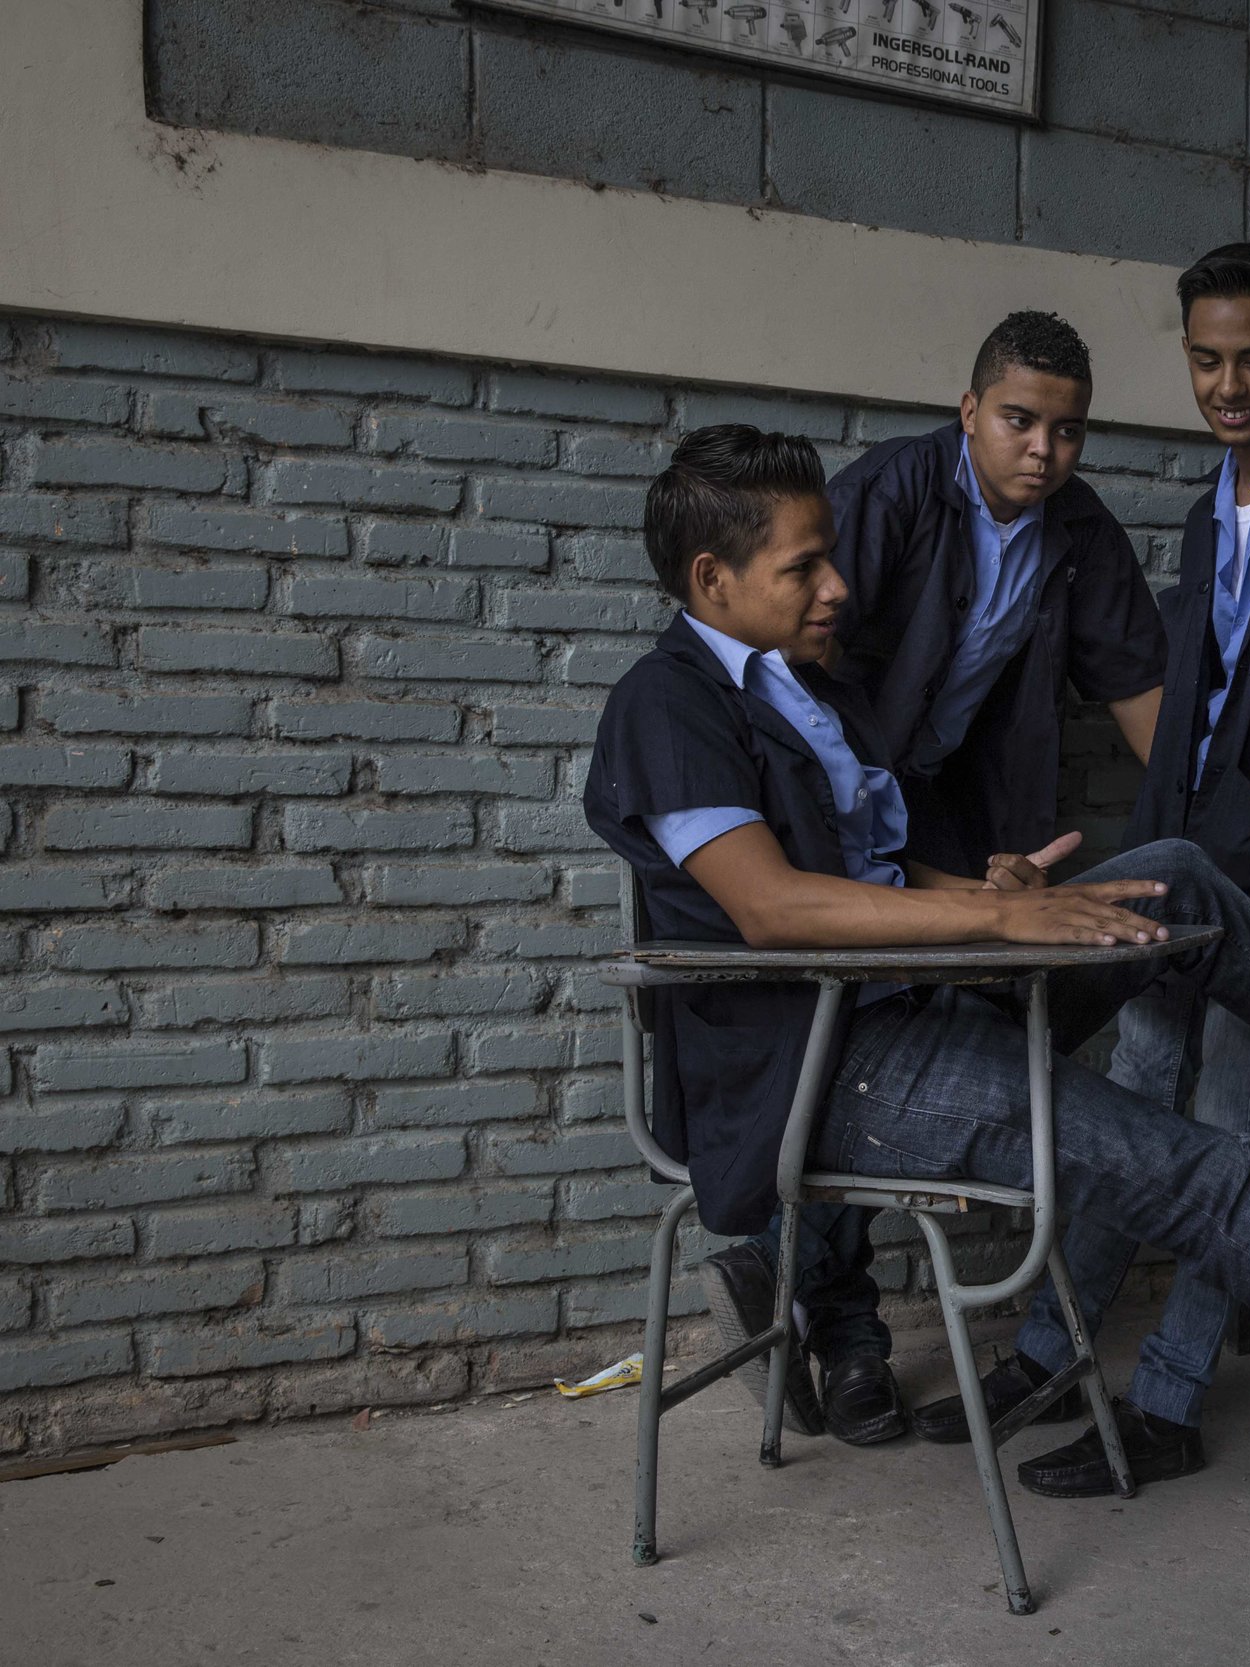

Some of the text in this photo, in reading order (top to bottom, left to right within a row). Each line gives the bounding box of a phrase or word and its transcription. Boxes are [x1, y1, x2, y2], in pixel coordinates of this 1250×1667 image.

[872, 32, 1011, 75] INGERSOLL-RAND
[872, 55, 966, 87] PROFESSIONAL
[968, 76, 1010, 96] TOOLS
